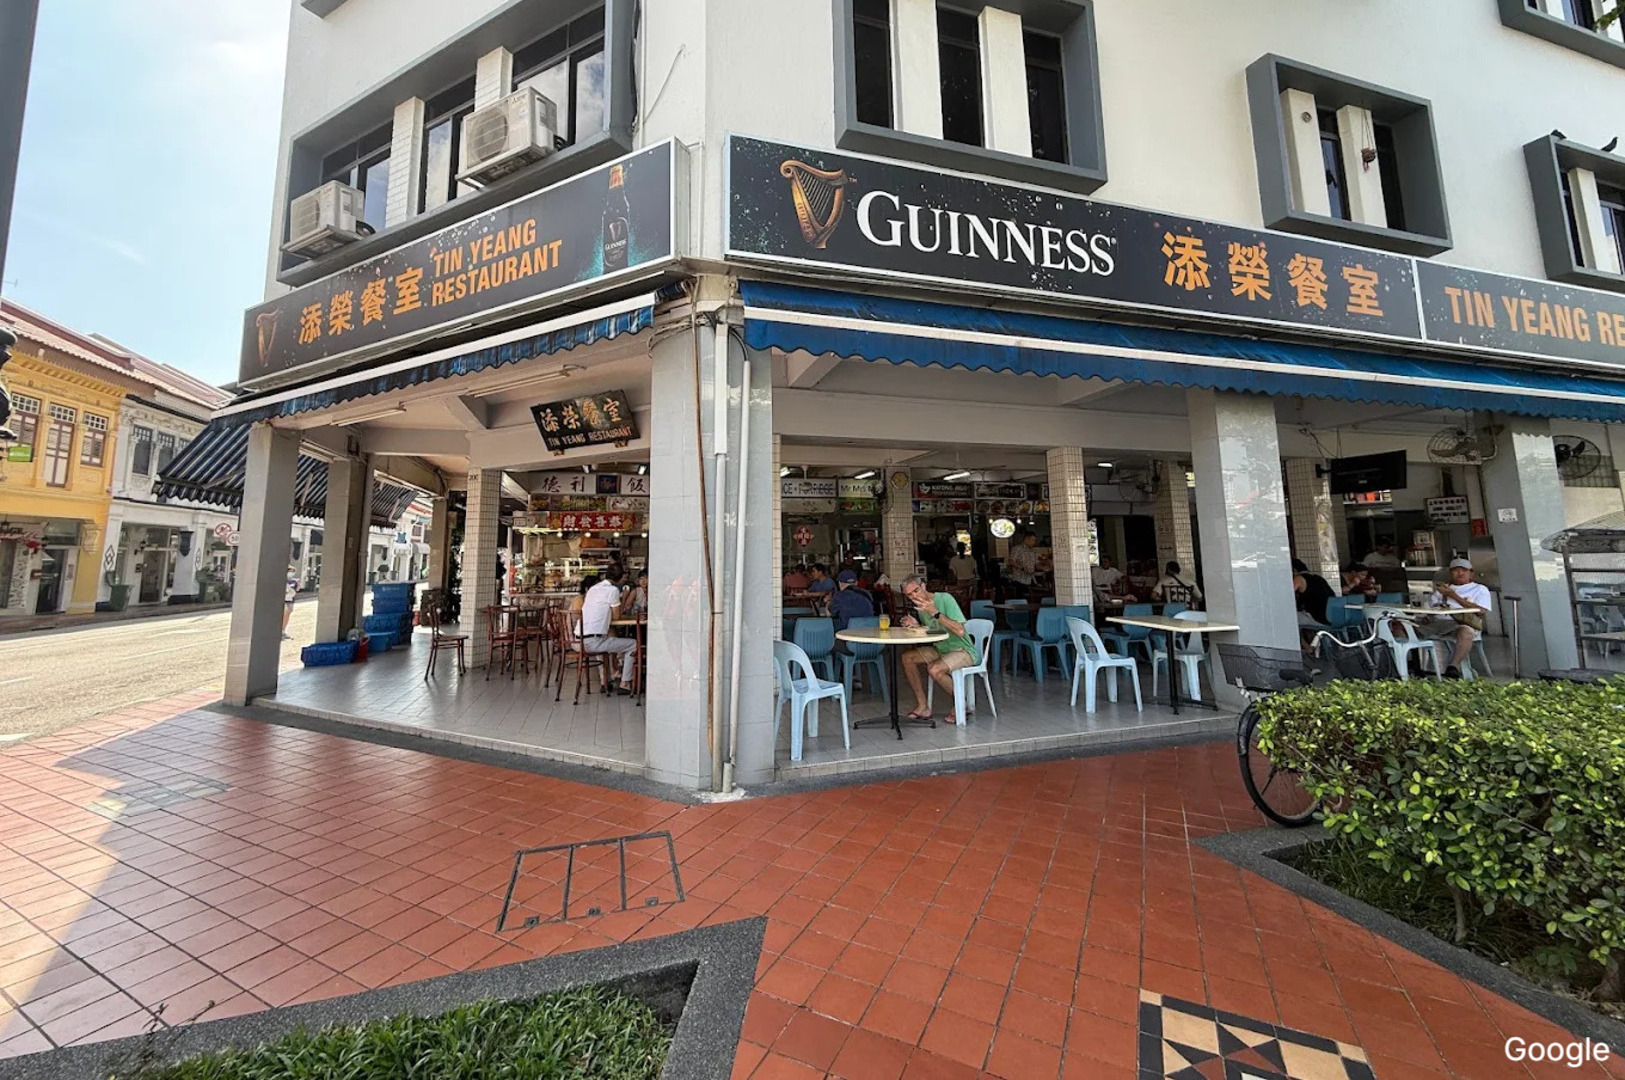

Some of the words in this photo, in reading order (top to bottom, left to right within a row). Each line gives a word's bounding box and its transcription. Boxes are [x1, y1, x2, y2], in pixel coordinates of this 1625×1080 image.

[433, 246, 463, 277] TIN
[469, 218, 536, 264] YEANG
[857, 191, 1114, 276] GUINNESS
[298, 267, 424, 345] 添榮餐室
[432, 239, 563, 307] RESTAURANT
[1161, 230, 1384, 317] 添榮餐室
[1444, 286, 1495, 329] TIN
[1501, 295, 1591, 342] YEANG
[1596, 311, 1625, 347] RE
[548, 437, 561, 447] TIN
[561, 433, 586, 445] YEANG
[588, 425, 633, 441] RESTAURANT
